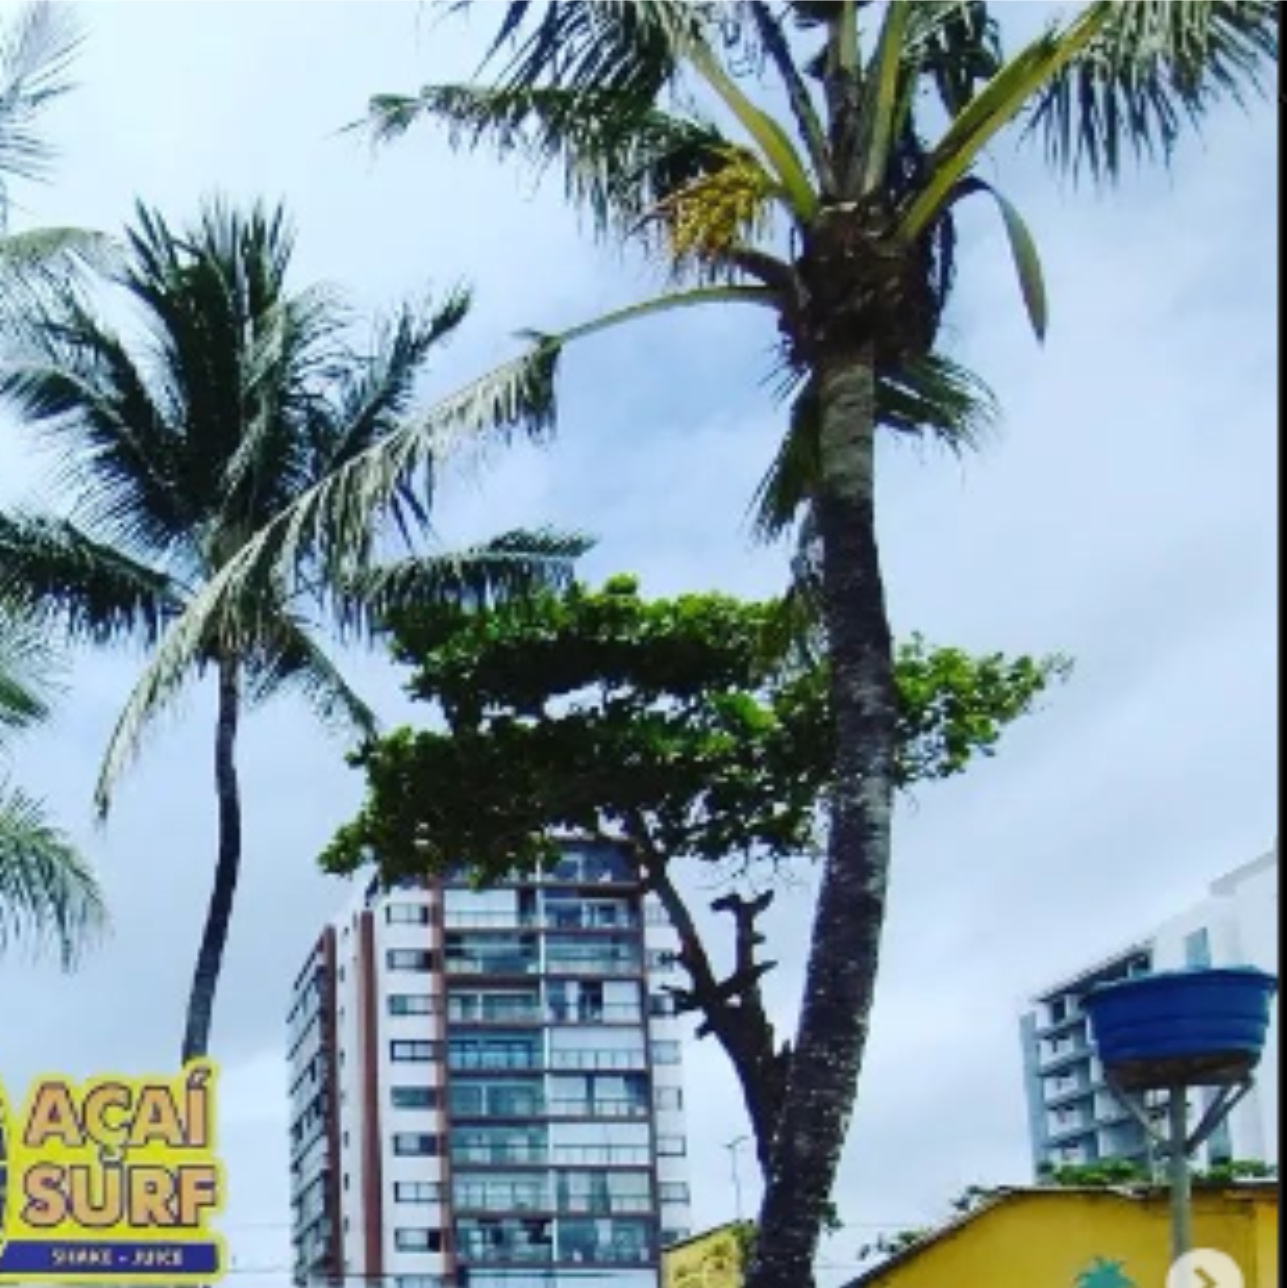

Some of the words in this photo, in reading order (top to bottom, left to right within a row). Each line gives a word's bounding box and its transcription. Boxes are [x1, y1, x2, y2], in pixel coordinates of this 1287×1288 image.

[24, 1066, 211, 1162] AÇAÍ
[22, 1164, 216, 1228] SURF
[132, 1248, 184, 1267] JUICE
